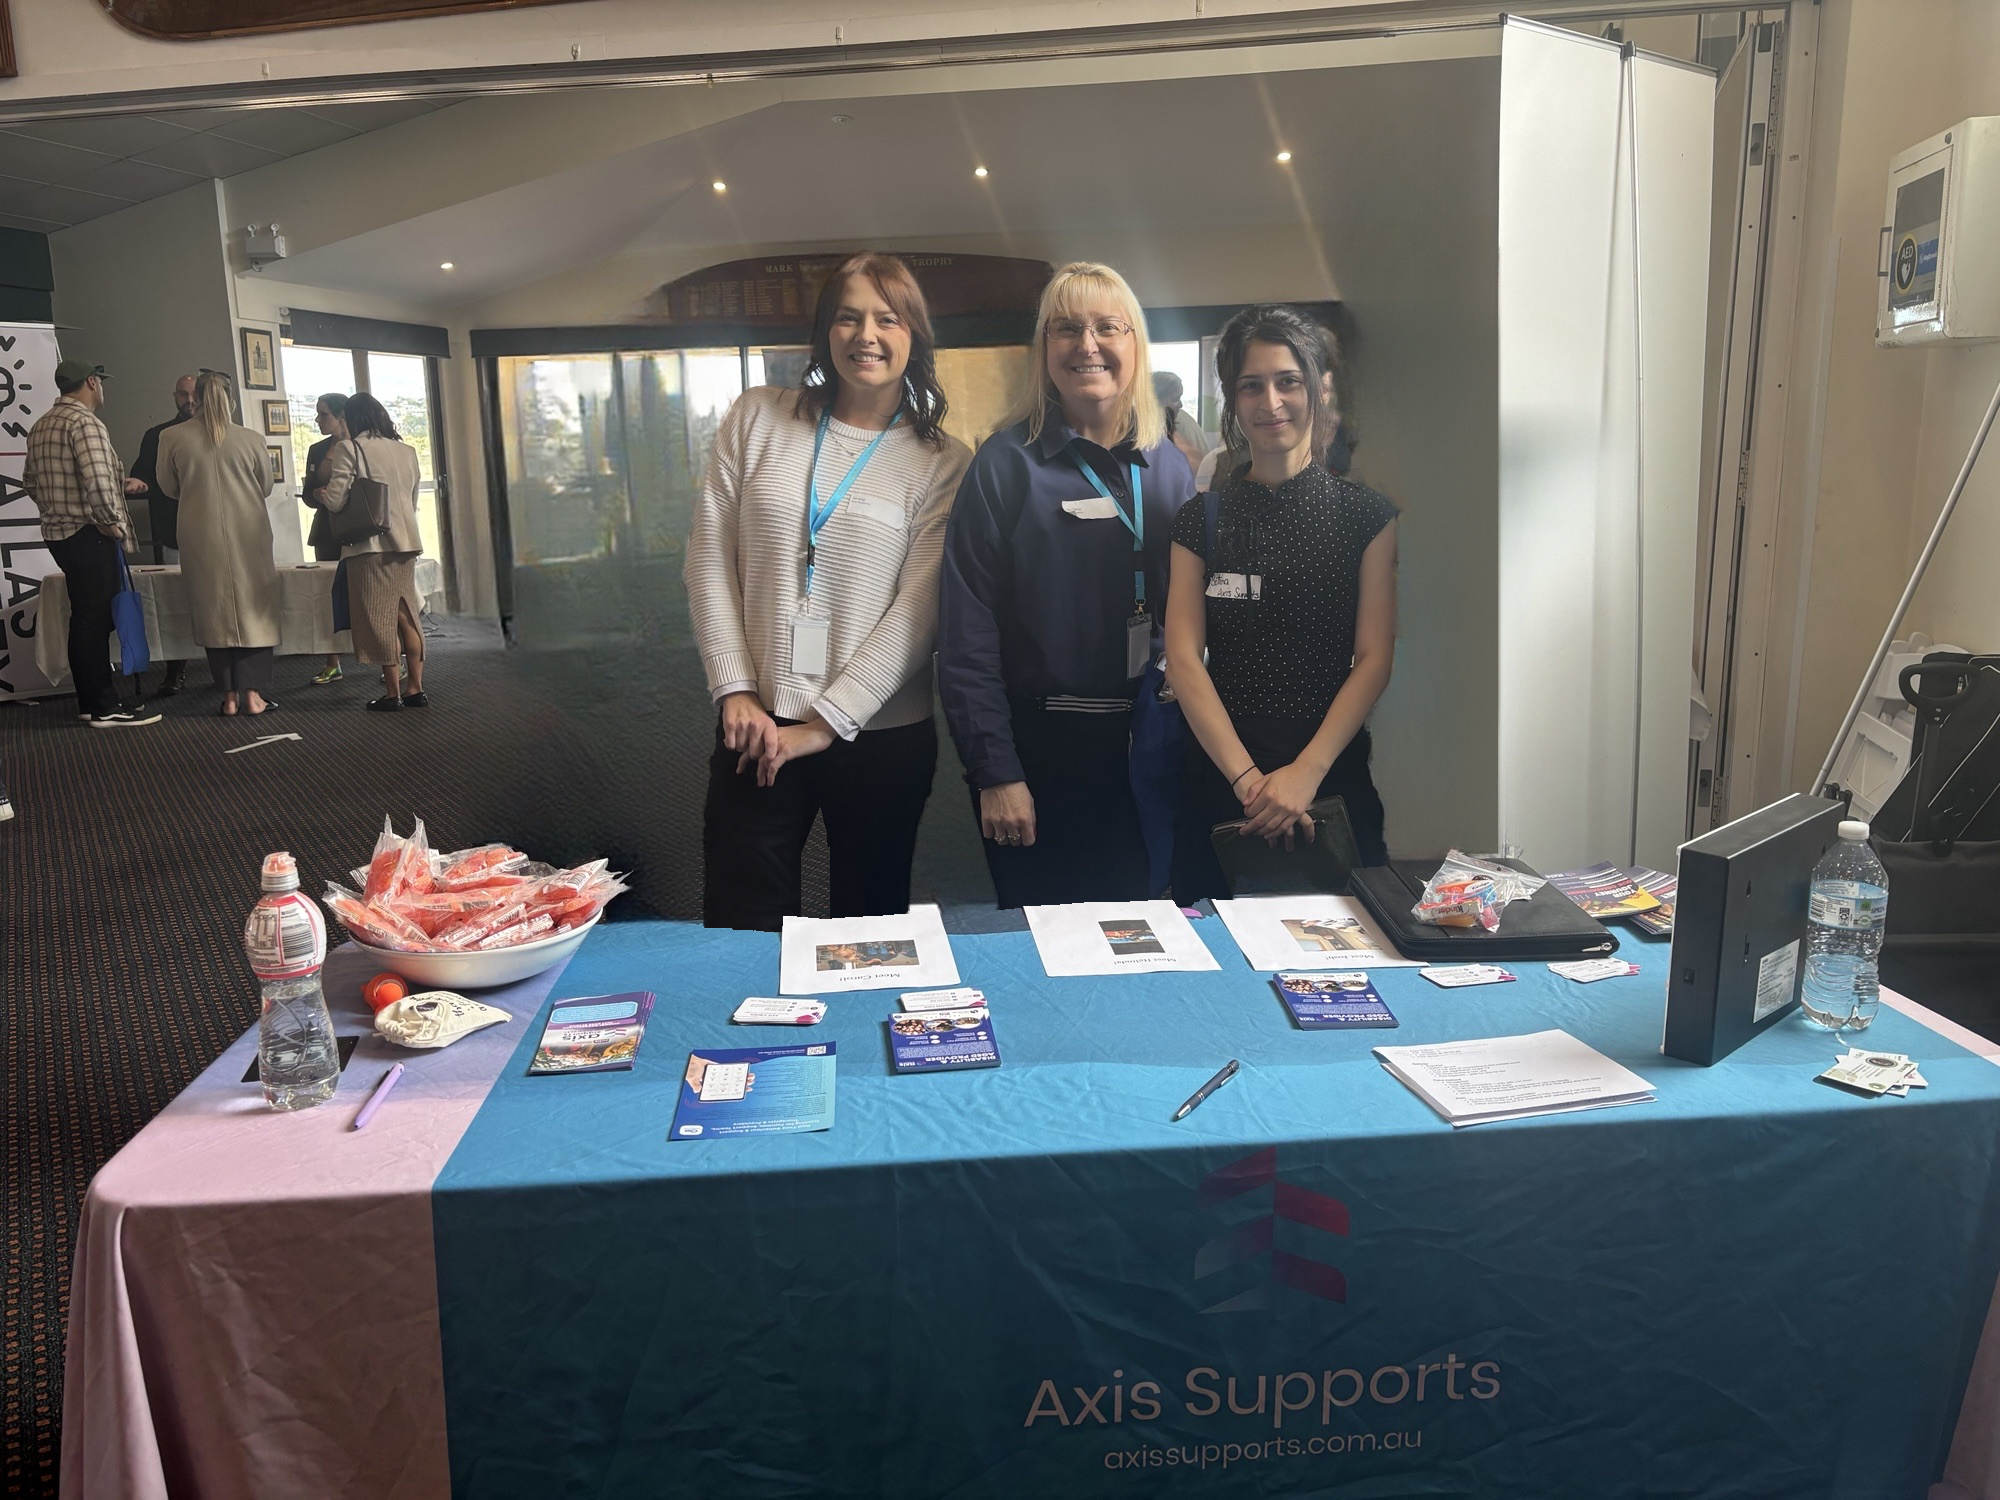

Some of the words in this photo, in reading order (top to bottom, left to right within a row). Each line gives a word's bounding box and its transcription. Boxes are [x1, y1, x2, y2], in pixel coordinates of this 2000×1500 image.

[1901, 245, 1914, 260] AED
[766, 264, 793, 273] MARK
[912, 256, 954, 268] TROPHY
[1566, 884, 1616, 895] COMMITMENT
[1619, 880, 1632, 888] OUR
[1594, 884, 1633, 897] JOURNEY
[1613, 889, 1636, 899] YOUR
[562, 1034, 600, 1042] axis
[925, 1054, 969, 1062] PROVIDER
[950, 1056, 996, 1064] DISABILITY
[1024, 1368, 1162, 1429] Axis
[1184, 1353, 1502, 1429] Supports
[1104, 1426, 1422, 1470] axissupports.com.au
